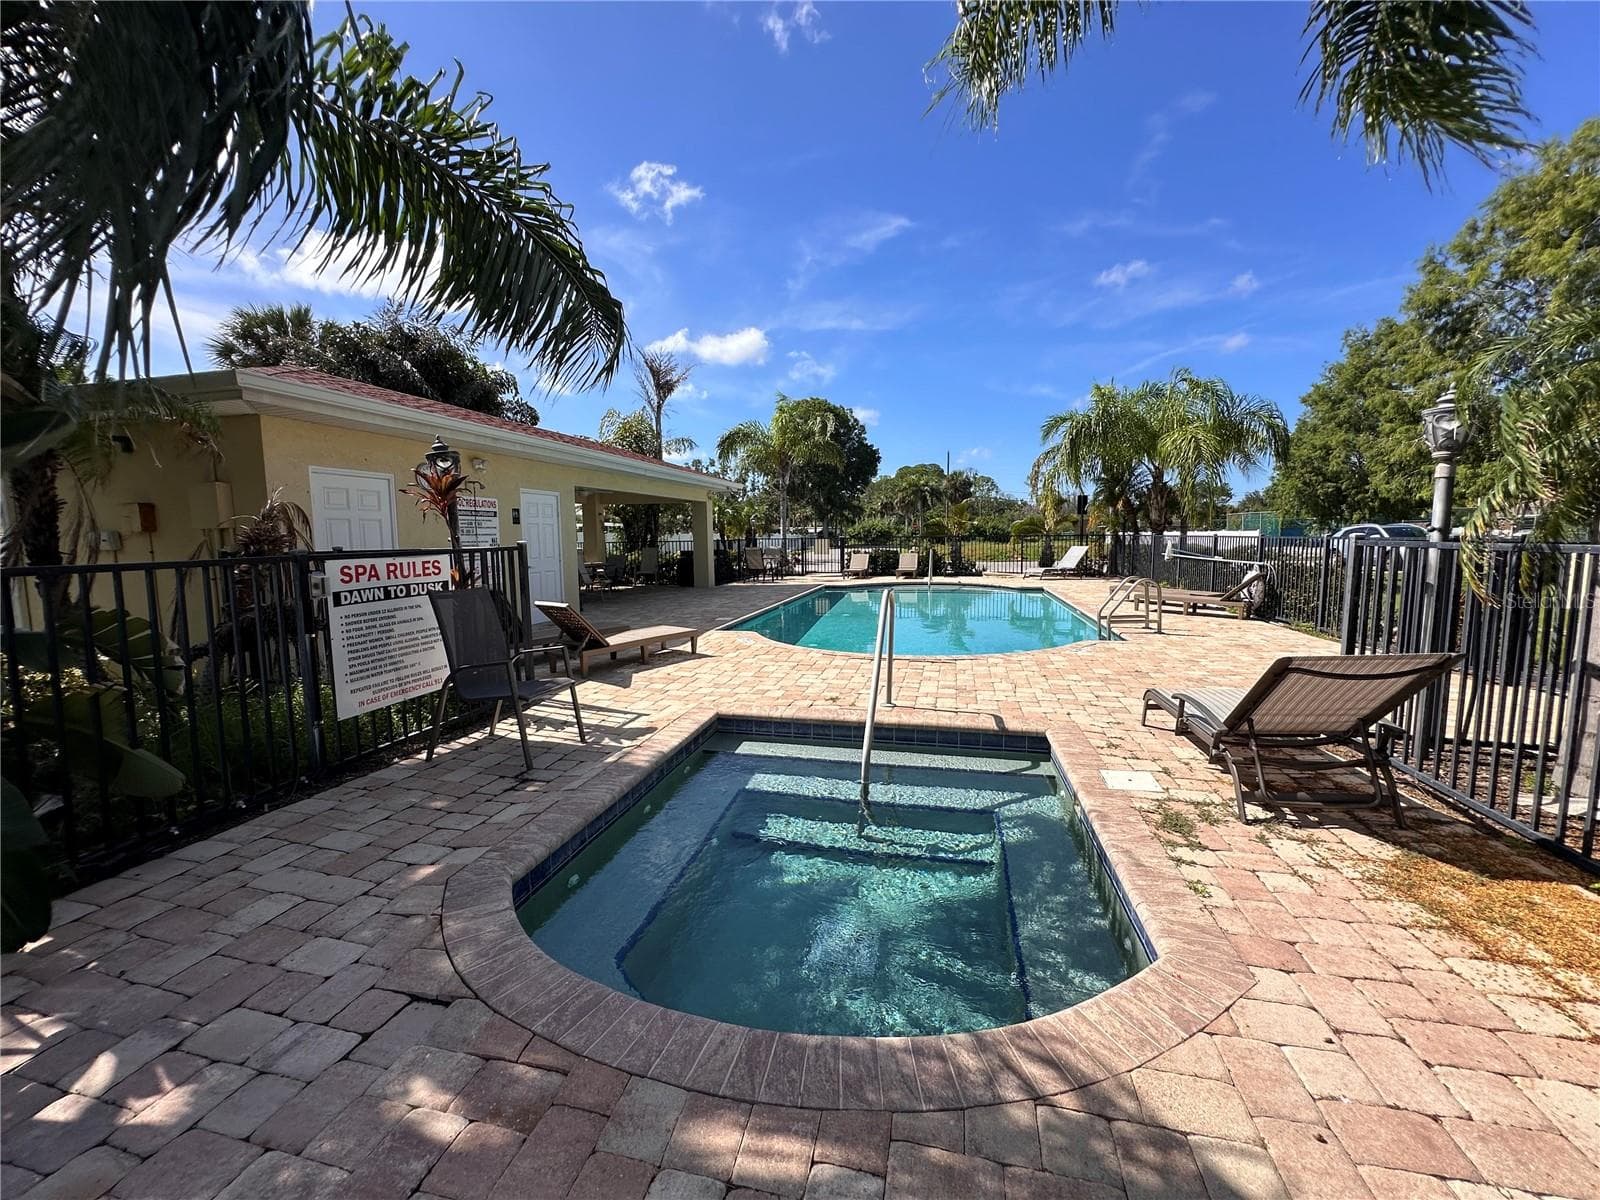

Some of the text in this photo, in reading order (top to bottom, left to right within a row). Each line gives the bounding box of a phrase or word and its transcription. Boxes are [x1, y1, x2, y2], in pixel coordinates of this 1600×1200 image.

[340, 560, 441, 585] SPA RULES
[341, 582, 443, 605] DAWN TO DUSK
[349, 668, 370, 676] MAXIMUM
[358, 699, 365, 707] IN
[366, 695, 381, 704] CASE
[390, 684, 421, 698] EMERGENCY
[422, 680, 433, 688] CALL
